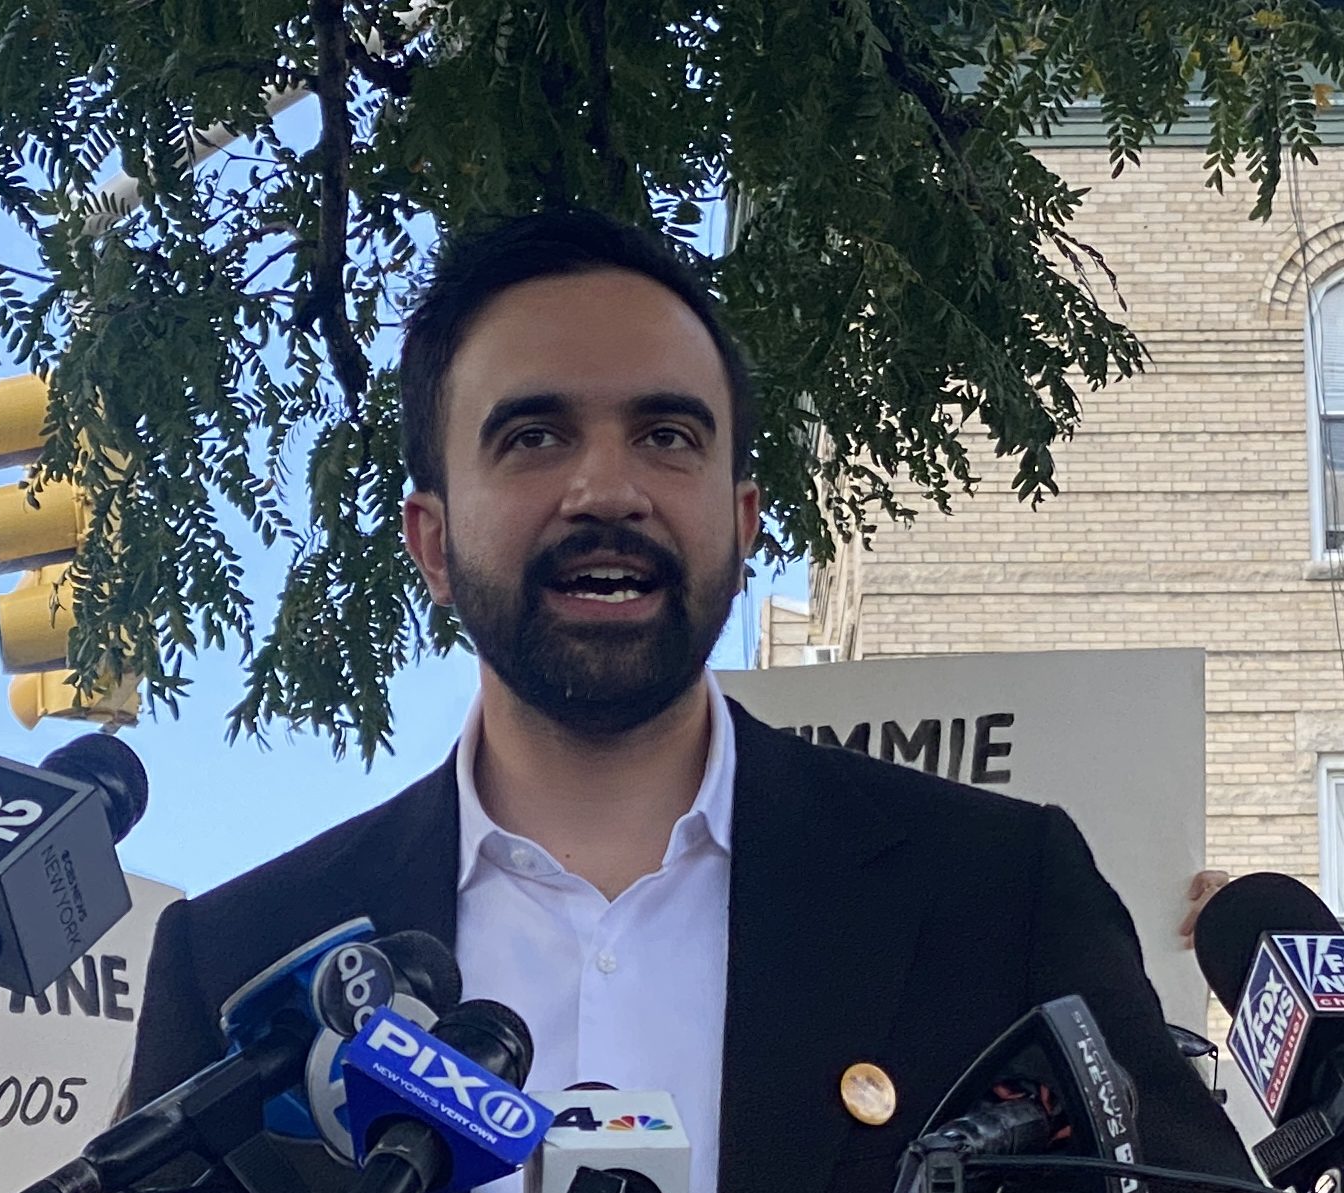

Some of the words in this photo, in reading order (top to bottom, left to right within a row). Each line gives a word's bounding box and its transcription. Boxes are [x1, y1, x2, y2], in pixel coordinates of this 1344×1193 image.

[41, 844, 67, 894] NEW
[56, 889, 82, 953] YORK
[1250, 969, 1286, 1044] FOX
[1258, 989, 1296, 1080] NEWS
[366, 1019, 490, 1111] PIX
[372, 1062, 400, 1084] NEW
[399, 1079, 439, 1110] YORK'S
[440, 1104, 472, 1128] VERY
[467, 1123, 498, 1145] OWN
[1077, 1039, 1120, 1138] NEWS
[549, 1106, 603, 1132] 4
